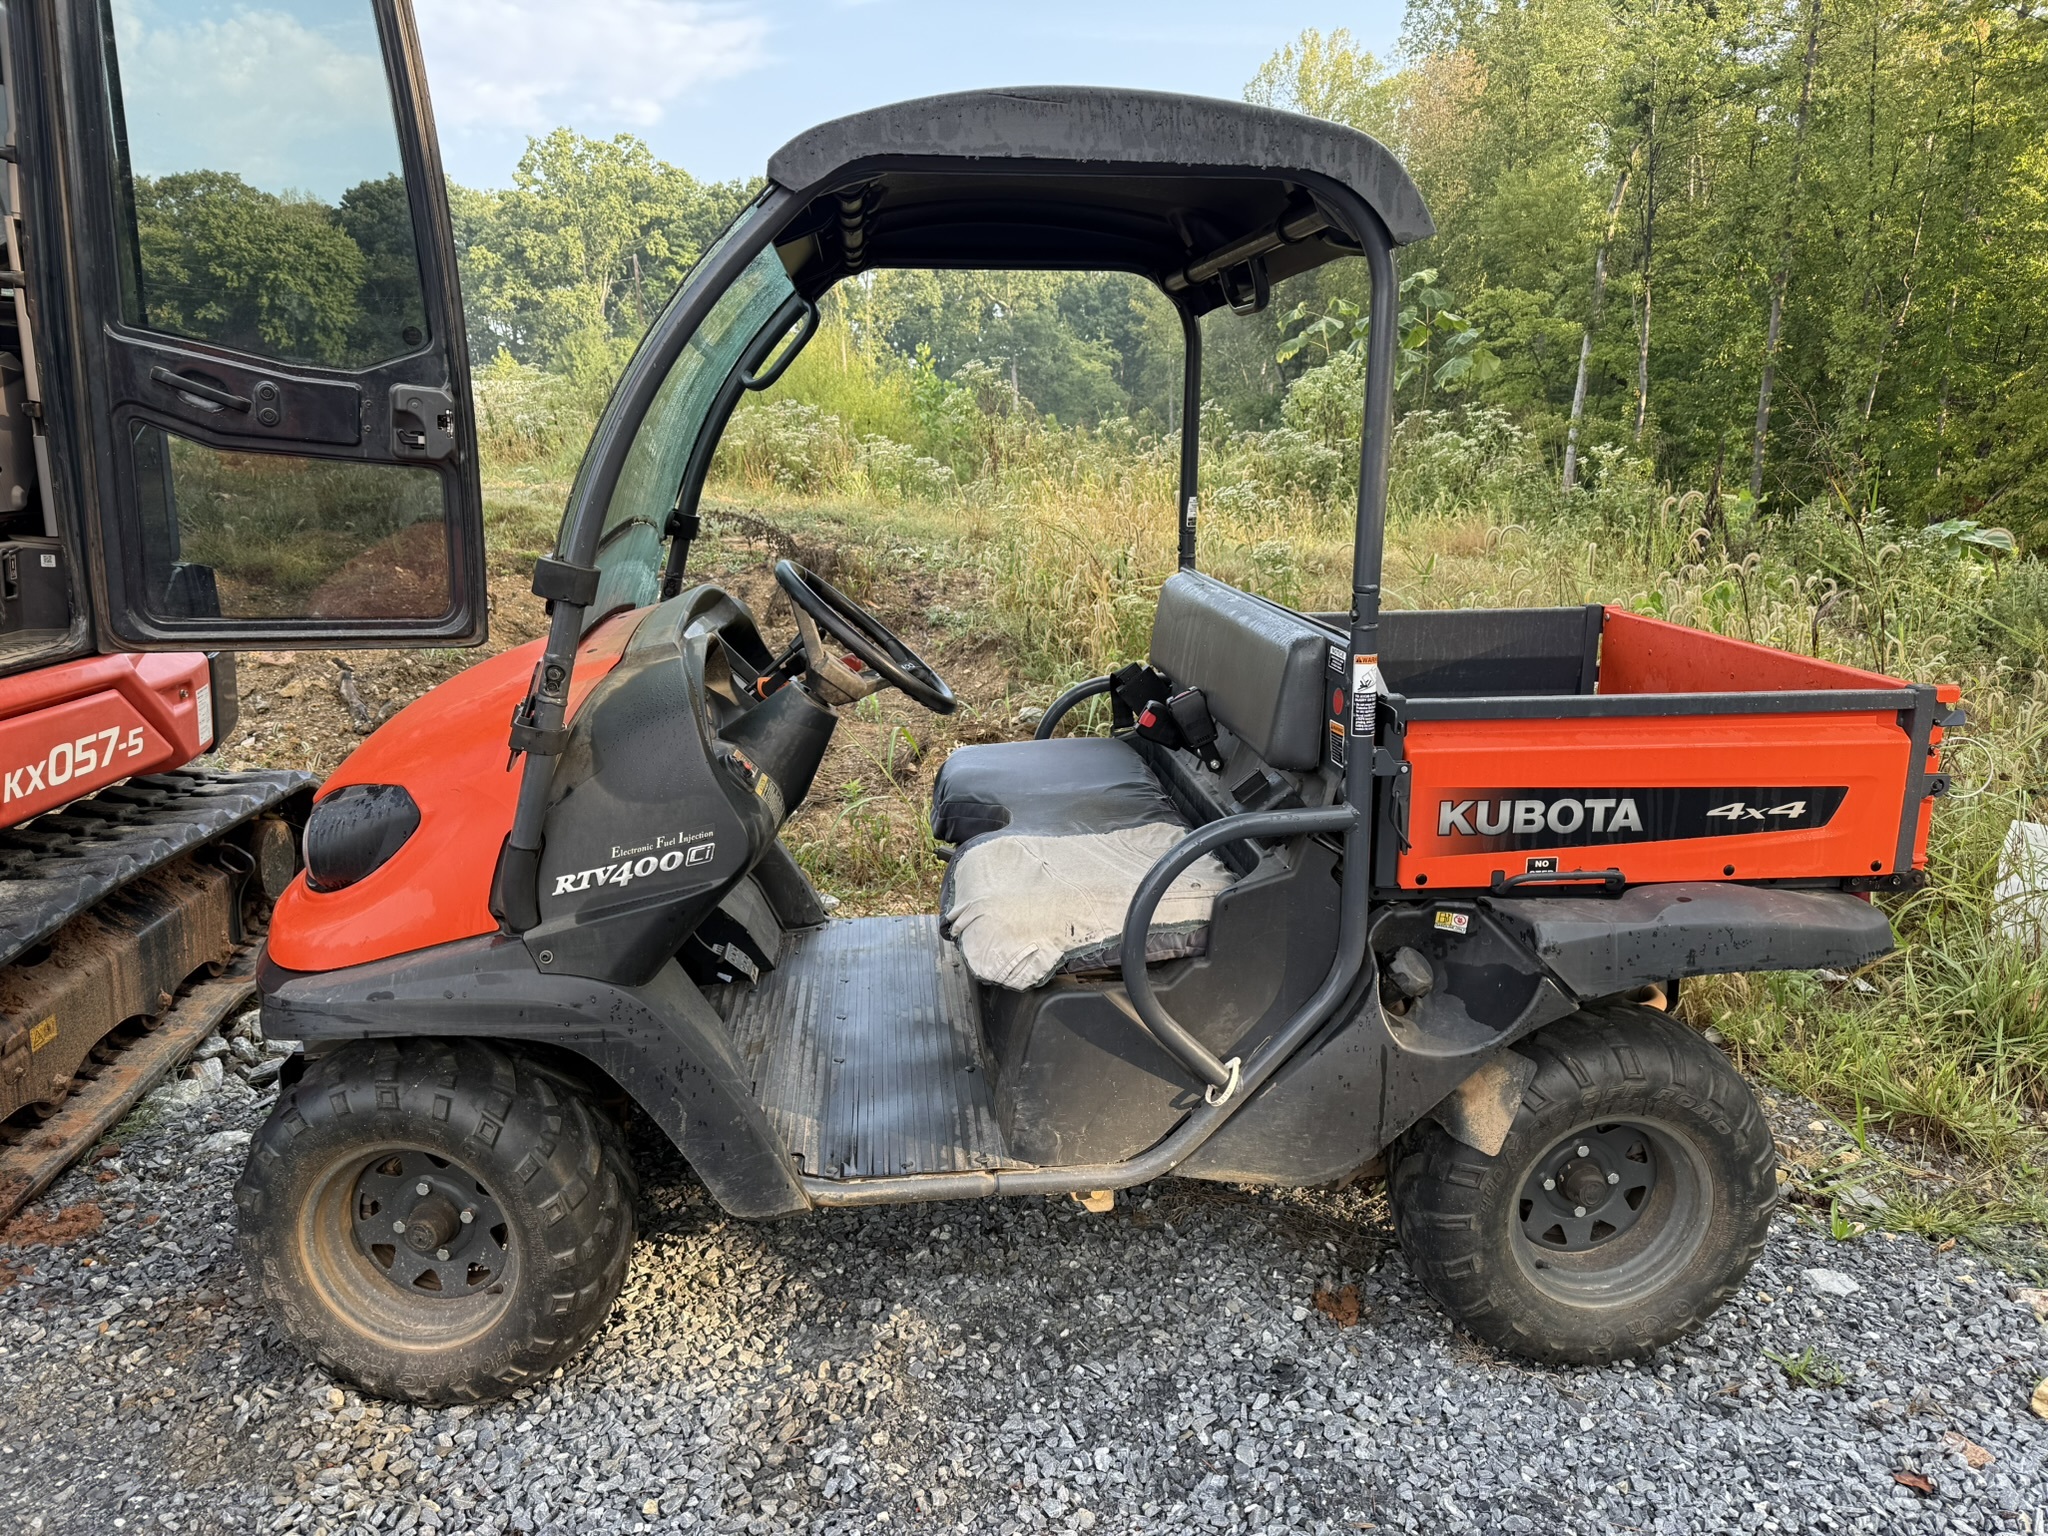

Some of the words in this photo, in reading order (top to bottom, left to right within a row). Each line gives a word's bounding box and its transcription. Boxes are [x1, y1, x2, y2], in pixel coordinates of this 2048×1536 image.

[4, 726, 144, 803] KX057-5
[1438, 798, 1644, 836] KUBOTA
[1705, 800, 1807, 821] 4x4
[611, 843, 654, 859] Electronic
[656, 835, 676, 849] Fuel
[678, 830, 714, 844] Injection
[1535, 860, 1550, 868] NO
[1480, 1166, 1505, 1214] 440
[1581, 1082, 1650, 1107] OFF
[1652, 1086, 1732, 1135] ROAD
[480, 1338, 522, 1375] 440
